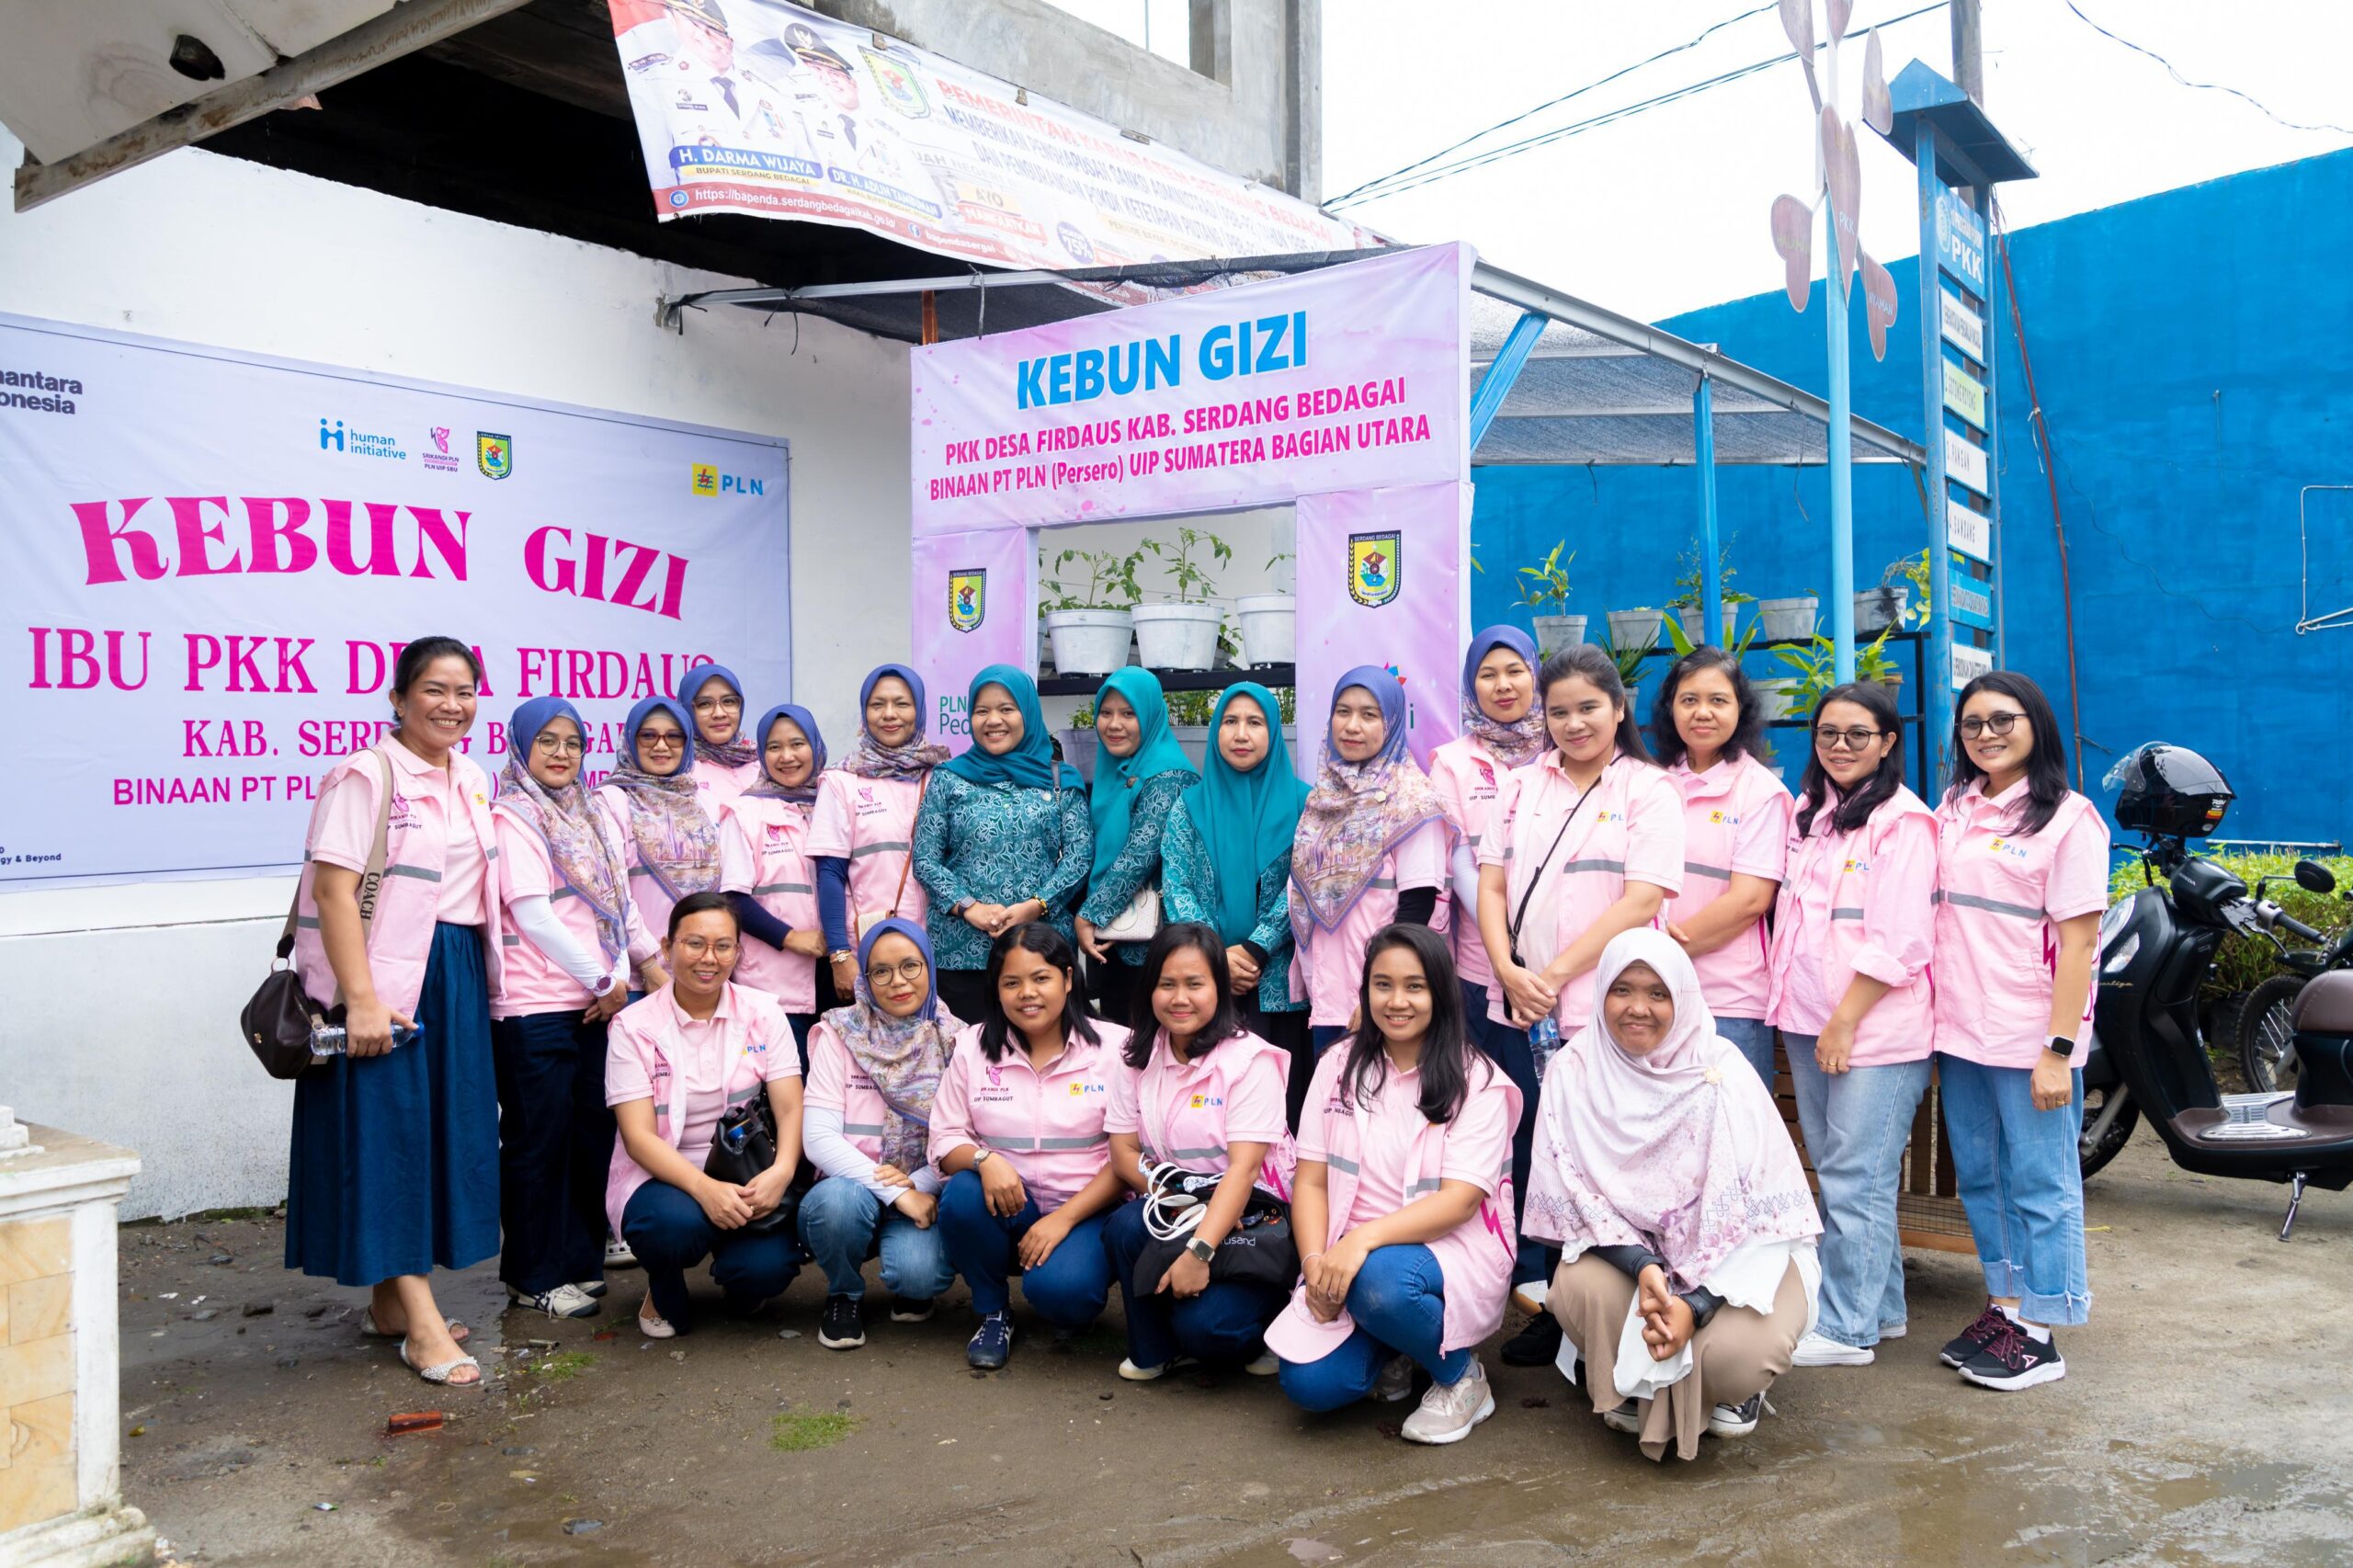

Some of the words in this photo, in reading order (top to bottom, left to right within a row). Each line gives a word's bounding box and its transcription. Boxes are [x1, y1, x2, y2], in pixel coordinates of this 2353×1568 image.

[678, 148, 699, 164] H.
[701, 149, 761, 168] DARMA
[762, 154, 817, 176] WIJAYA
[695, 166, 730, 176] BUPATI
[730, 168, 772, 181] SERDANG
[773, 173, 811, 186] BEDAGAI
[1951, 235, 1984, 285] PKK
[1017, 334, 1181, 410] KEBUN
[1199, 311, 1306, 381] GIZI
[946, 438, 981, 466] PKK
[985, 432, 1030, 461] DESA
[1036, 419, 1122, 454] FIRDAUS
[1127, 412, 1177, 443] KAB.
[1183, 395, 1290, 436] SERDANG
[1297, 377, 1406, 419] BEDAGAI
[350, 428, 395, 446] human
[350, 441, 406, 460] initiative
[930, 472, 989, 501] BINAAN
[993, 469, 1012, 494] PT
[1016, 464, 1047, 491] PLN
[1051, 454, 1124, 492] (Persero)
[1130, 450, 1160, 477] UIP
[1164, 437, 1266, 474] SUMATERA
[1271, 425, 1350, 460] BAGIAN
[1357, 414, 1432, 453] UTARA
[722, 474, 764, 496] PLN
[72, 496, 472, 585] KEBUN
[524, 525, 689, 621] GIZI
[28, 628, 152, 692] IBU
[183, 633, 318, 696] PKK
[517, 647, 715, 703] FIRDAU
[939, 696, 967, 713] PLN
[182, 720, 279, 757] KAB.
[113, 777, 231, 806] BINAAN
[242, 776, 278, 802] PT
[286, 775, 319, 801] PL
[26, 853, 63, 864] Beyond
[2002, 843, 2028, 858] PLN
[360, 871, 381, 921] COACH
[746, 1044, 767, 1054] PLN
[1084, 1085, 1105, 1093] PLN
[1203, 1097, 1223, 1107] PLN
